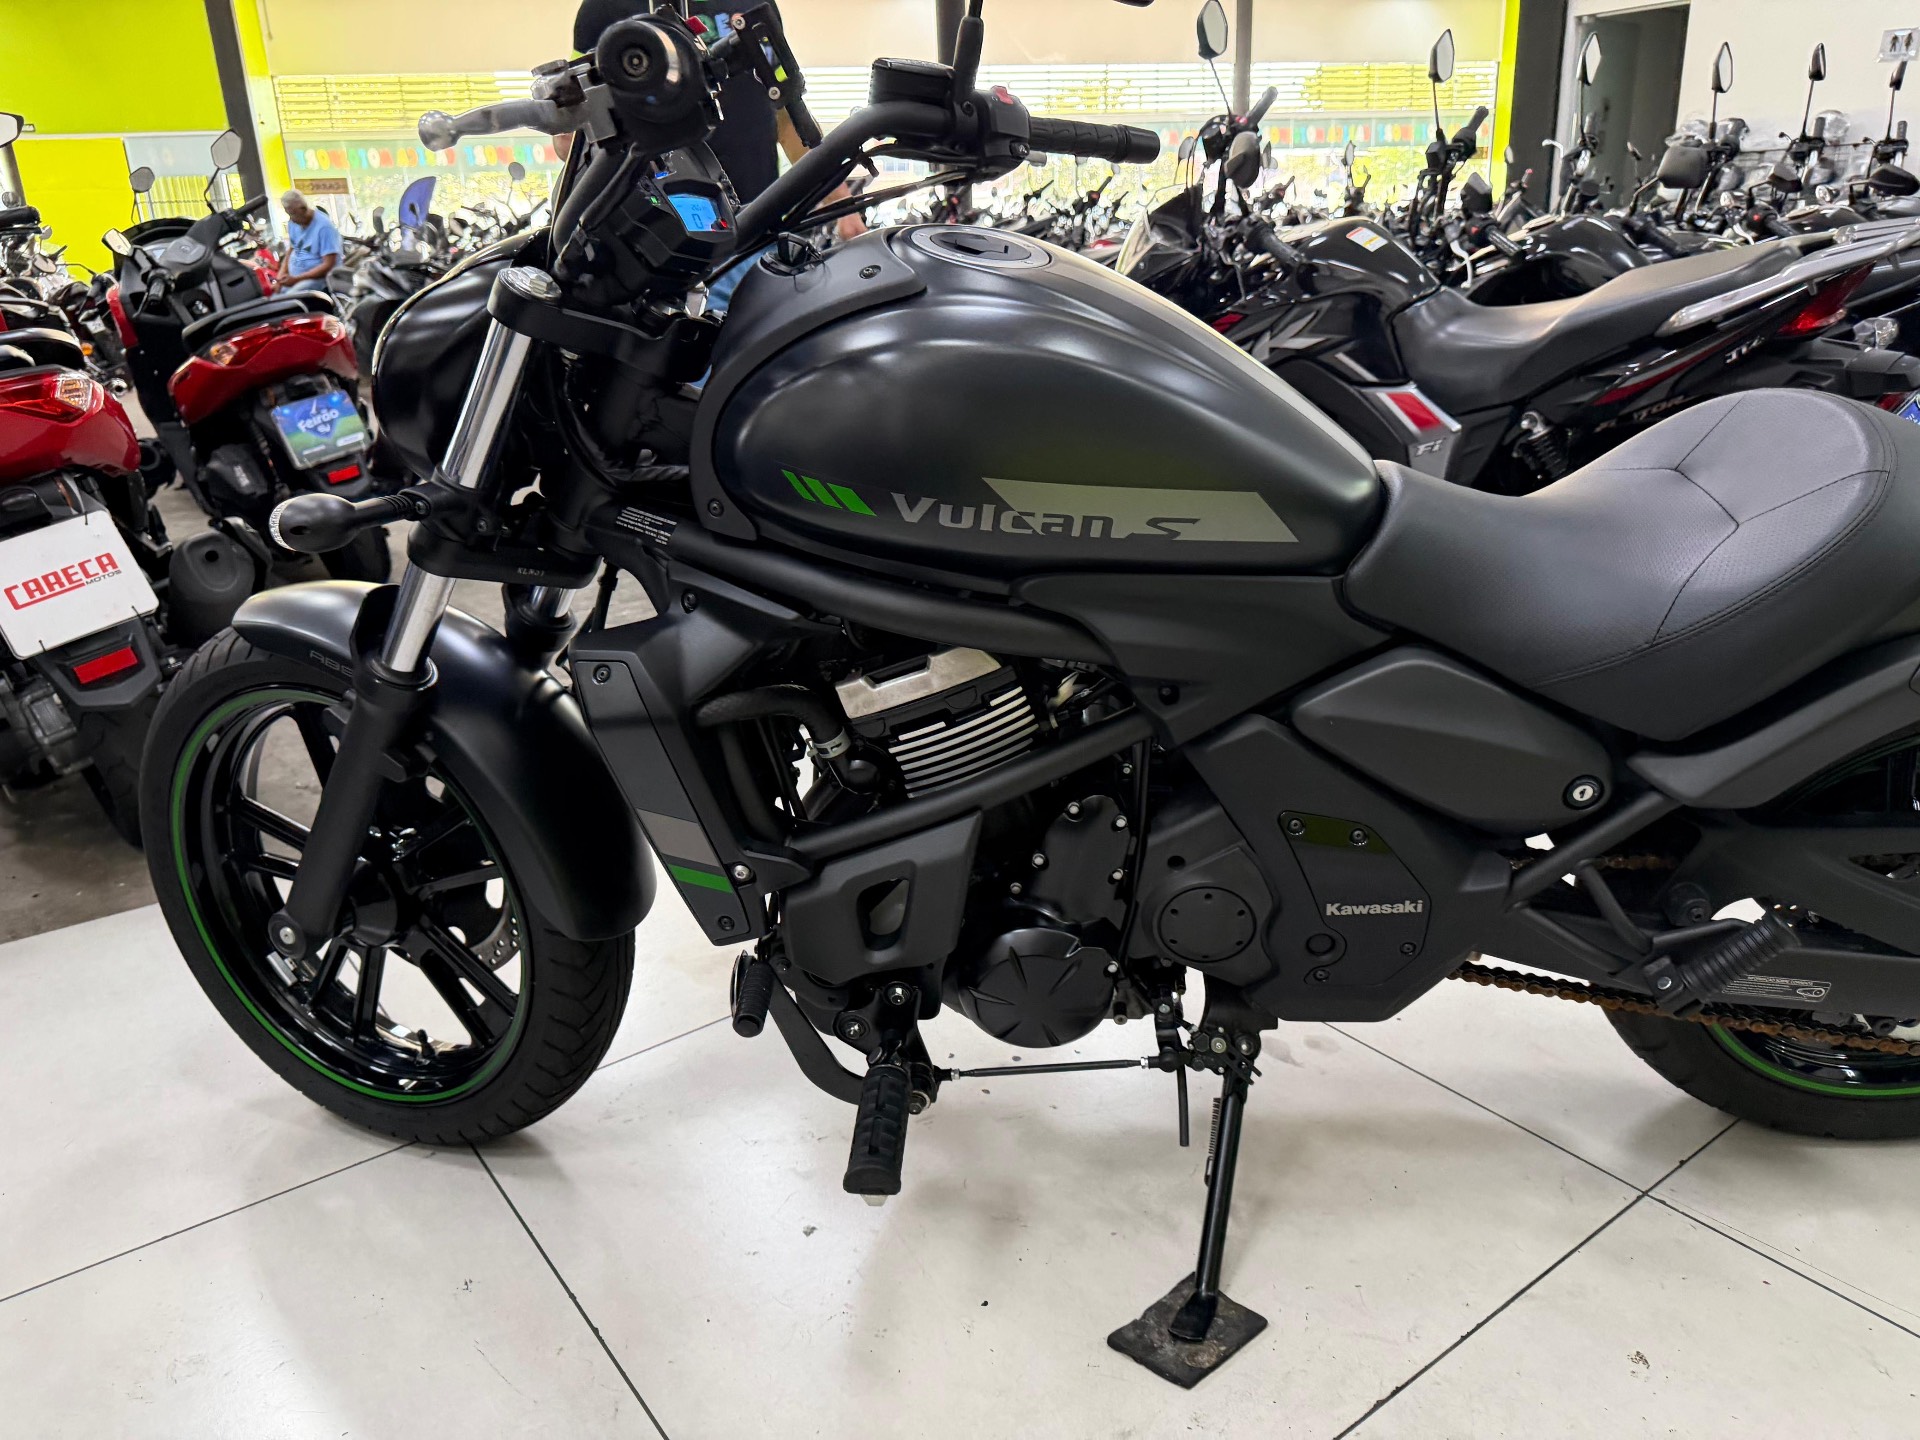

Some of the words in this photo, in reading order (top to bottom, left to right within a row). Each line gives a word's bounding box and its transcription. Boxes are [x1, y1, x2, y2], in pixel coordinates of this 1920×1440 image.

[890, 491, 1116, 539] Vulcan
[1133, 516, 1201, 540] S
[4, 552, 119, 611] CARECA
[85, 569, 122, 586] MOTOS
[1325, 900, 1424, 916] Kawasaki
